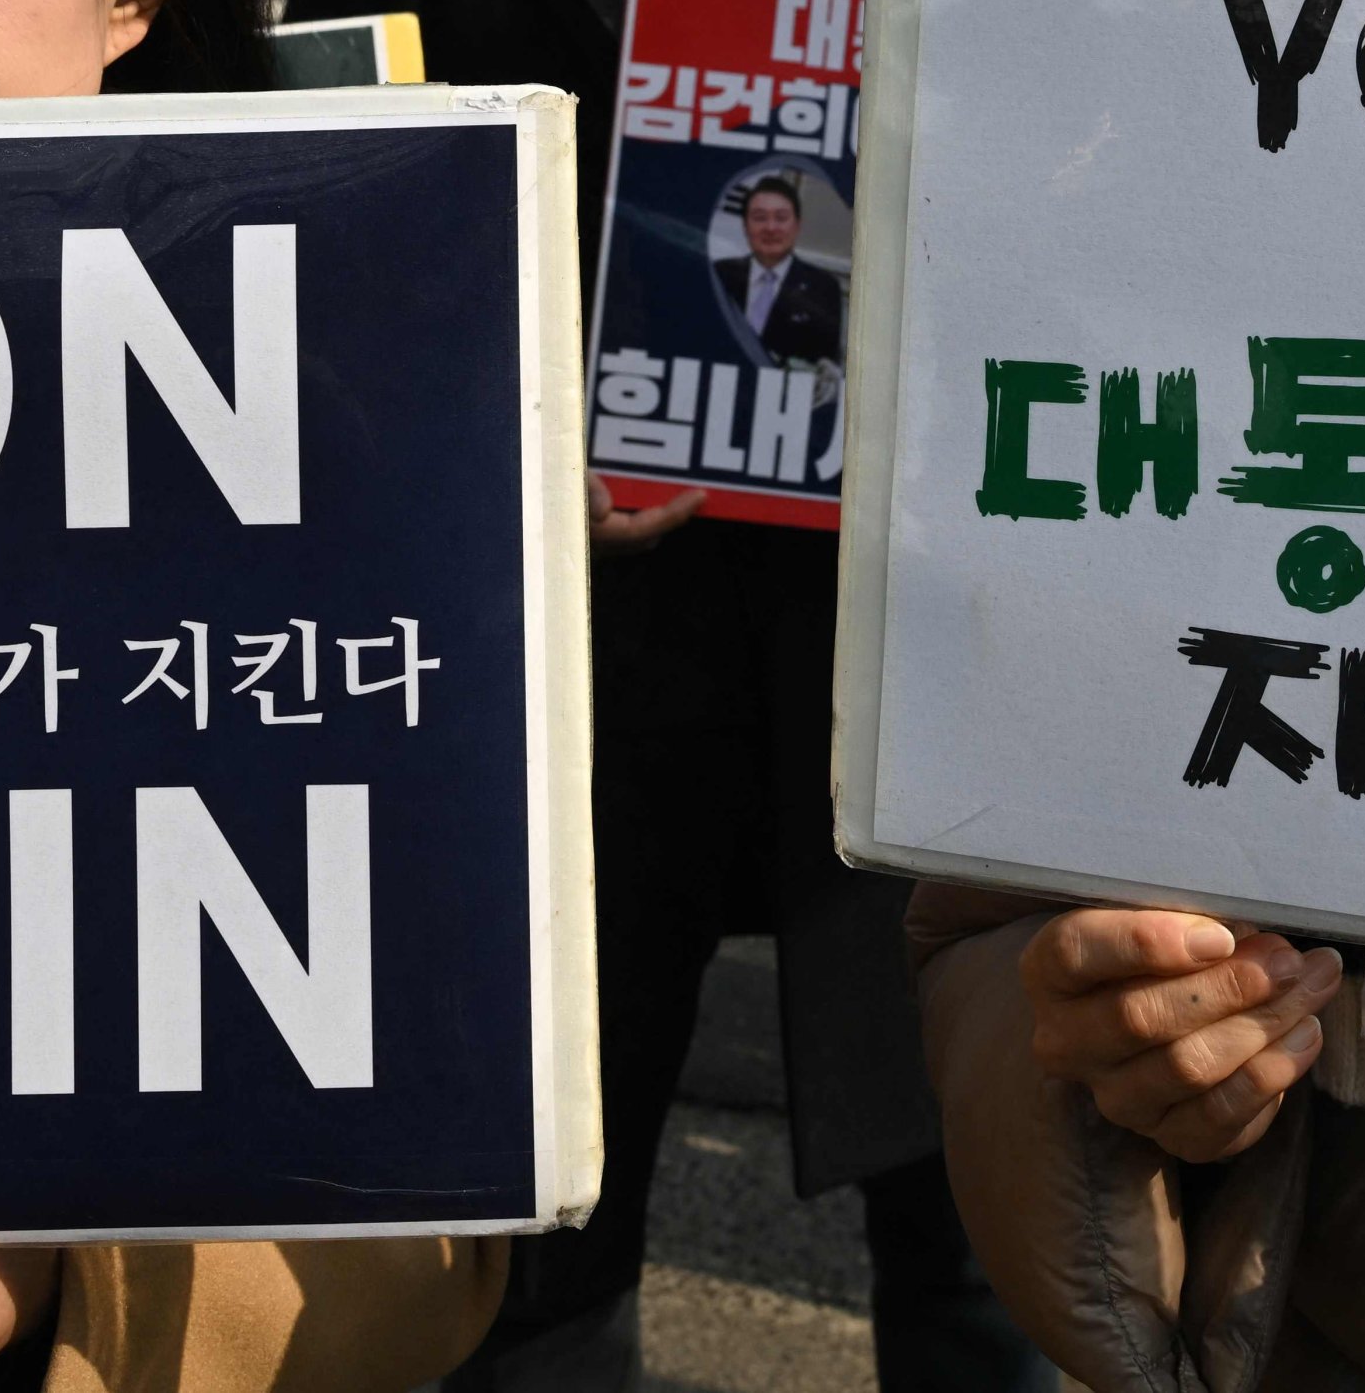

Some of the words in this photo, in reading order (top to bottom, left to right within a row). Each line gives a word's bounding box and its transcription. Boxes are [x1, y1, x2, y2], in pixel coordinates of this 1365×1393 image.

[623, 62, 860, 160] 김건희
[592, 348, 845, 484] 힘내
[121, 616, 441, 731] 지킨다
